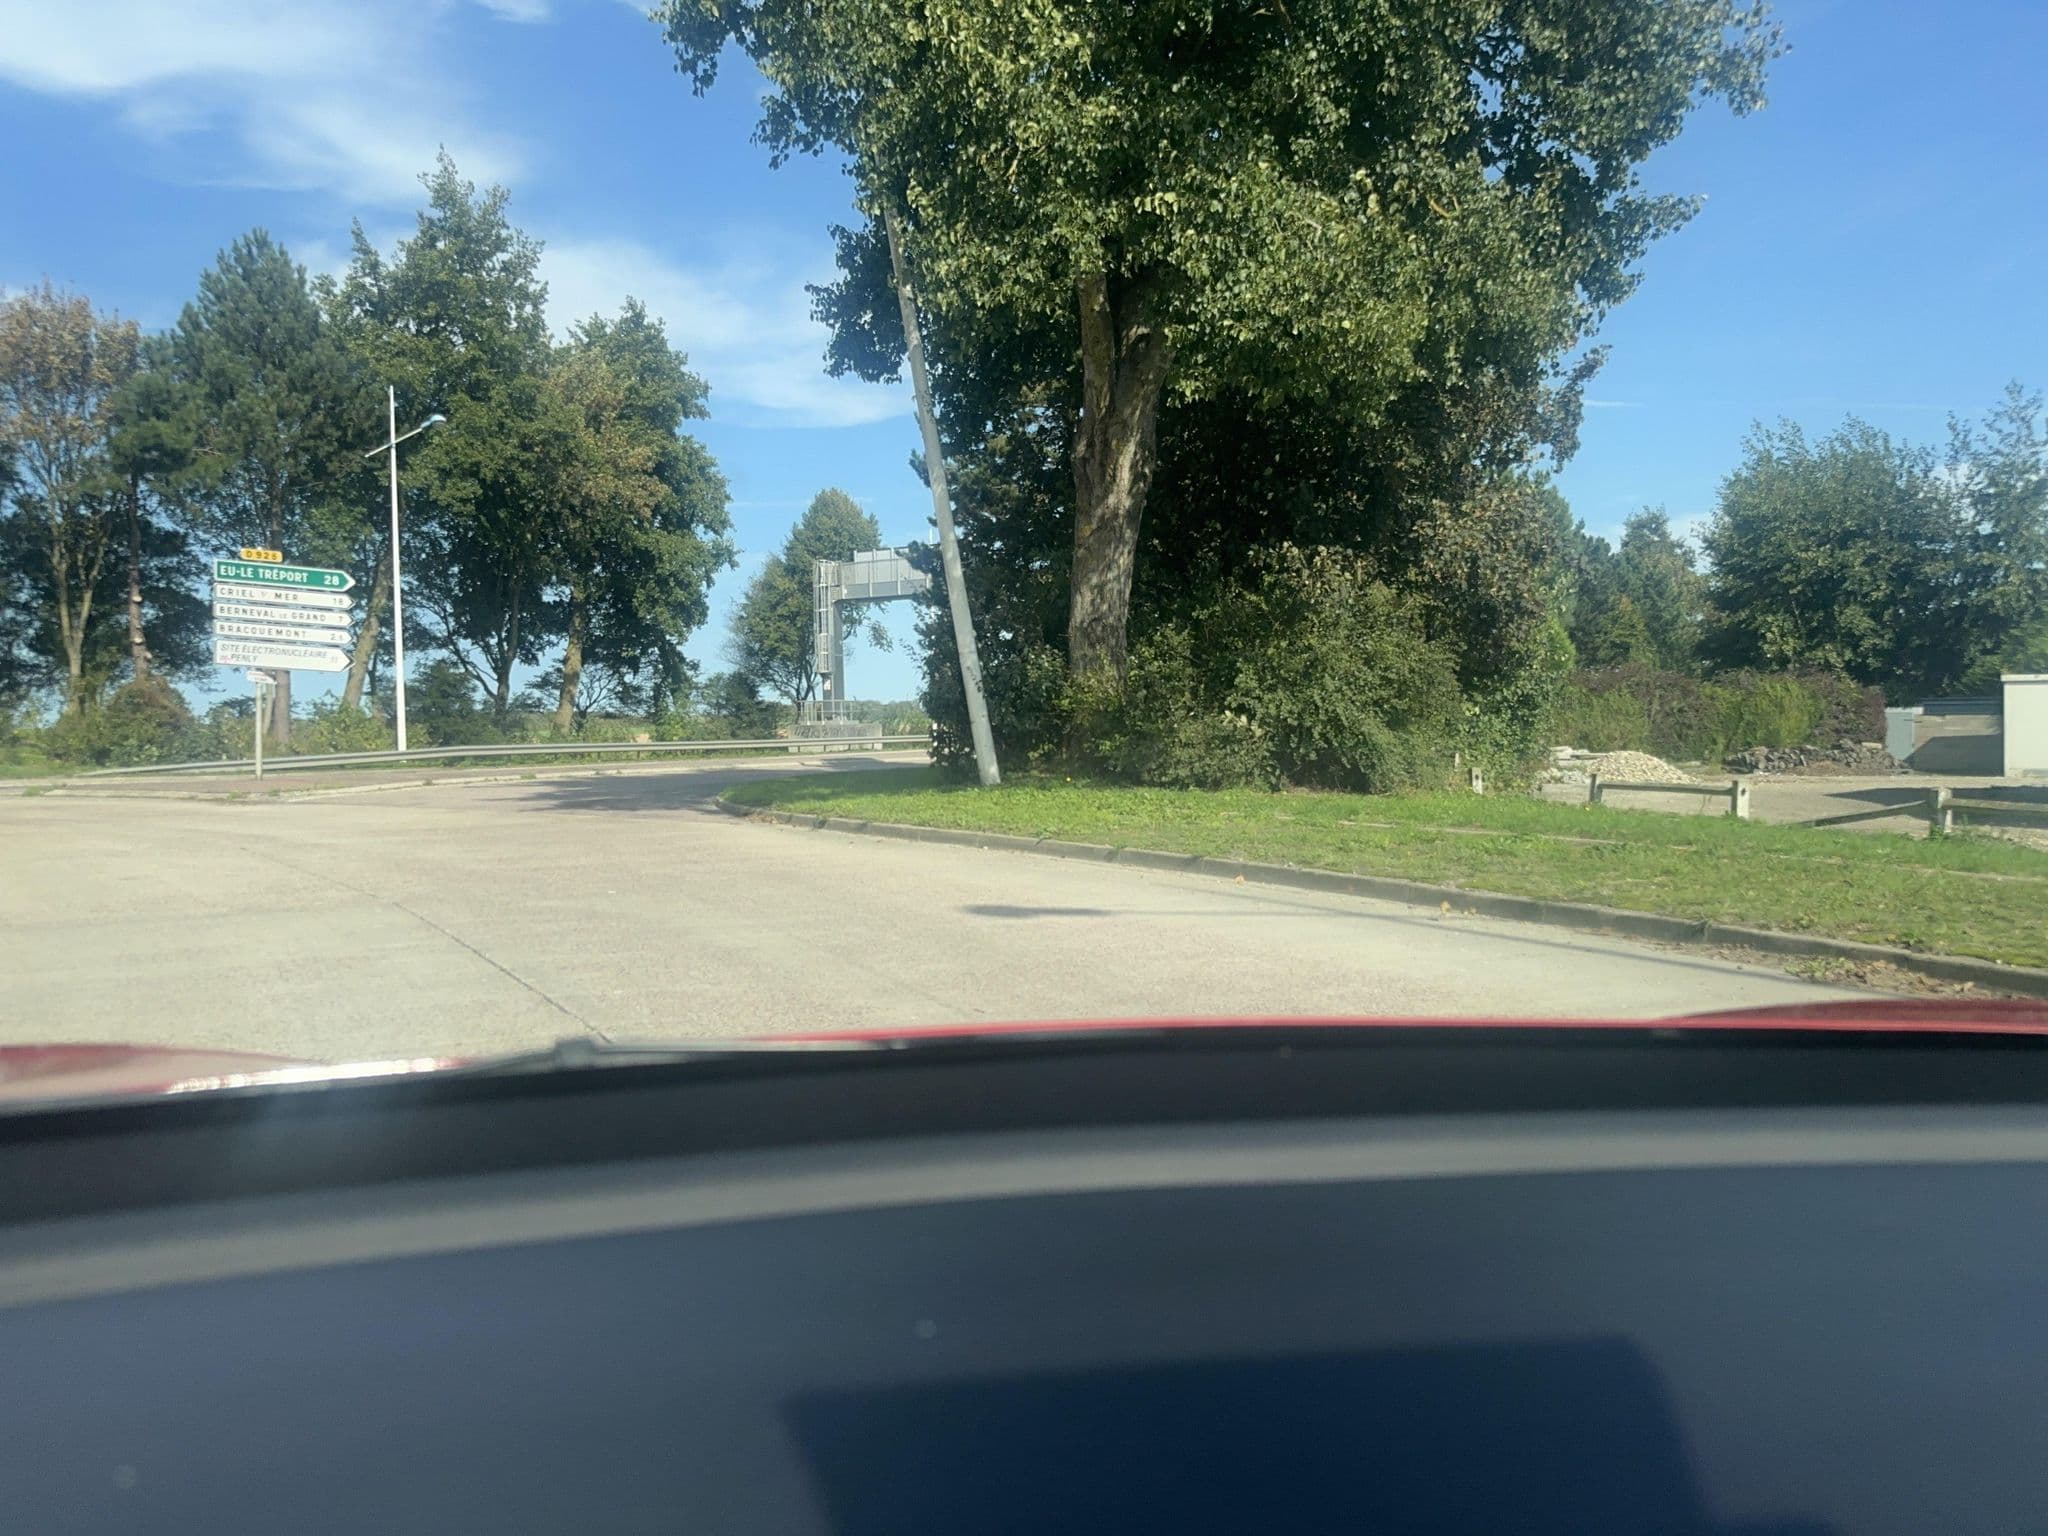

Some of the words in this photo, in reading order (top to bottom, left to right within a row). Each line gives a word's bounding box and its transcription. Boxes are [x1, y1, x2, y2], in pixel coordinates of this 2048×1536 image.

[219, 565, 255, 579] EU-LE
[258, 567, 309, 584] TRÉPORT
[323, 574, 340, 587] 28
[219, 587, 256, 599] CRIEL
[274, 592, 298, 602] MER
[219, 605, 275, 618] BERNEVAL
[291, 611, 327, 622] GRAND
[219, 624, 307, 637] BRACQUEMONT
